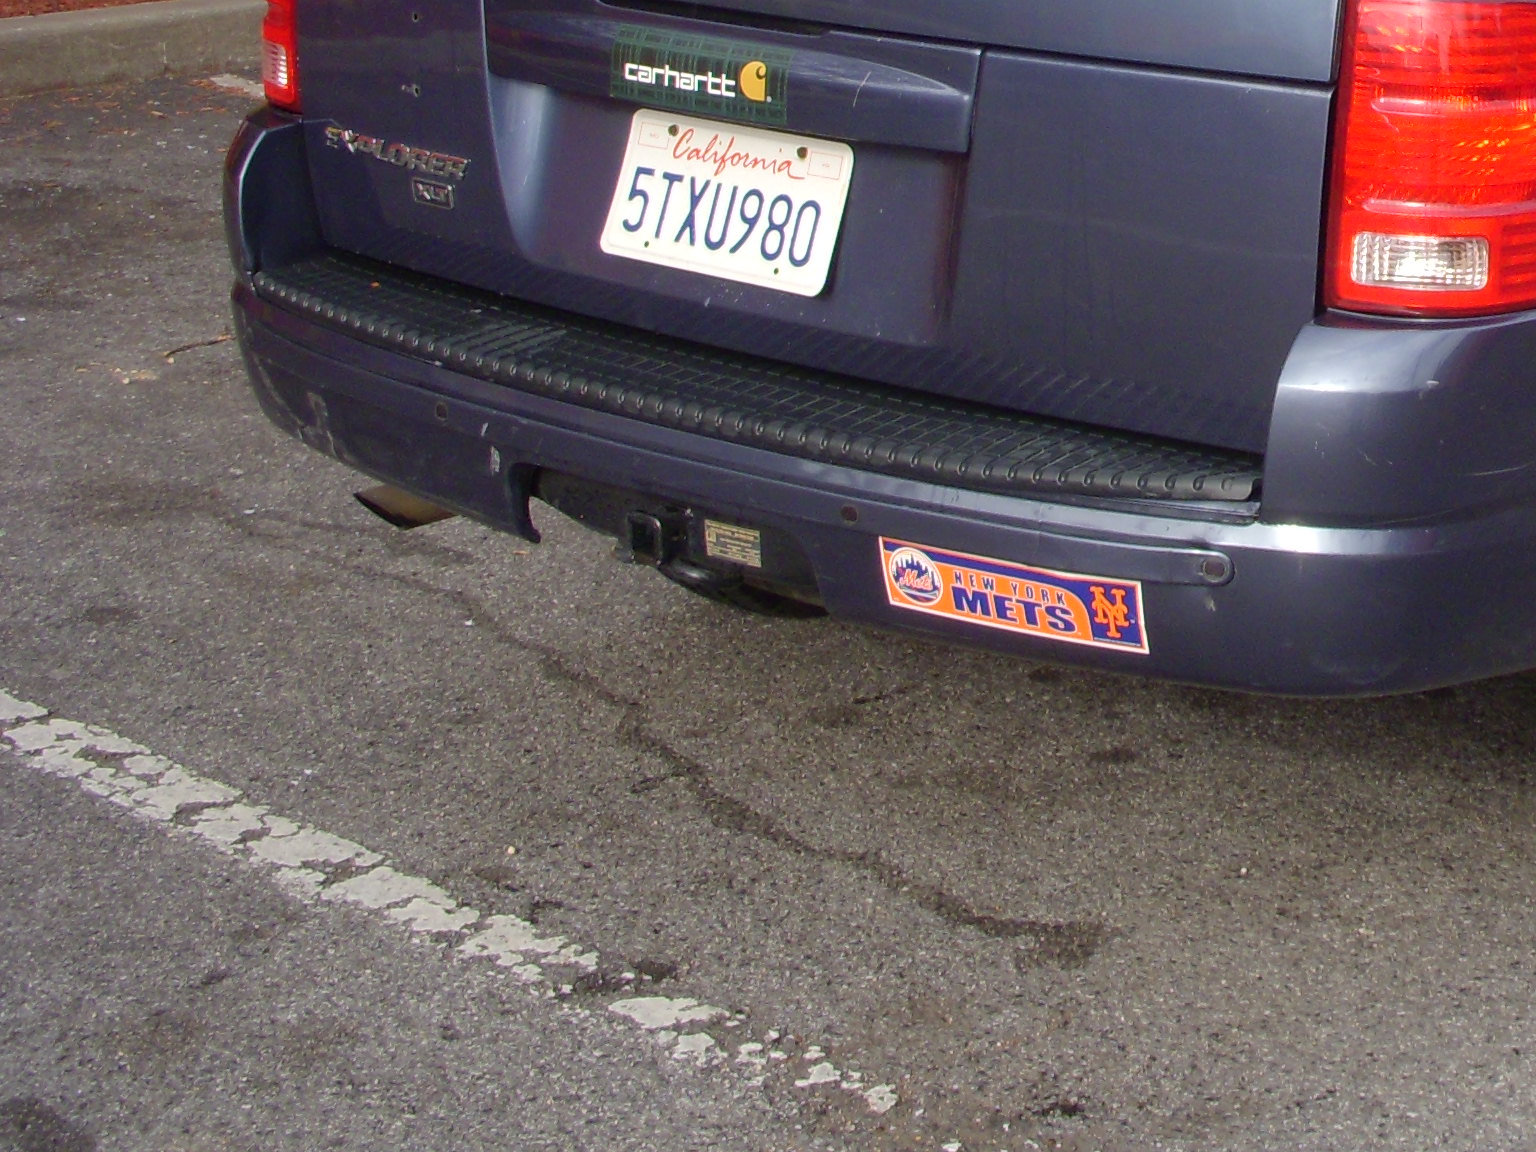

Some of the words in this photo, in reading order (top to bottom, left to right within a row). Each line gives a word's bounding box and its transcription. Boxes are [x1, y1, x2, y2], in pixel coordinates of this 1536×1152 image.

[623, 61, 737, 99] carhartt
[324, 125, 473, 181] EXPLORER
[671, 127, 806, 180] California
[621, 165, 822, 268] 5TXU980
[898, 567, 934, 591] Mets
[952, 570, 995, 591] NEW
[1010, 582, 1067, 606] YORK
[950, 585, 1078, 634] METS
